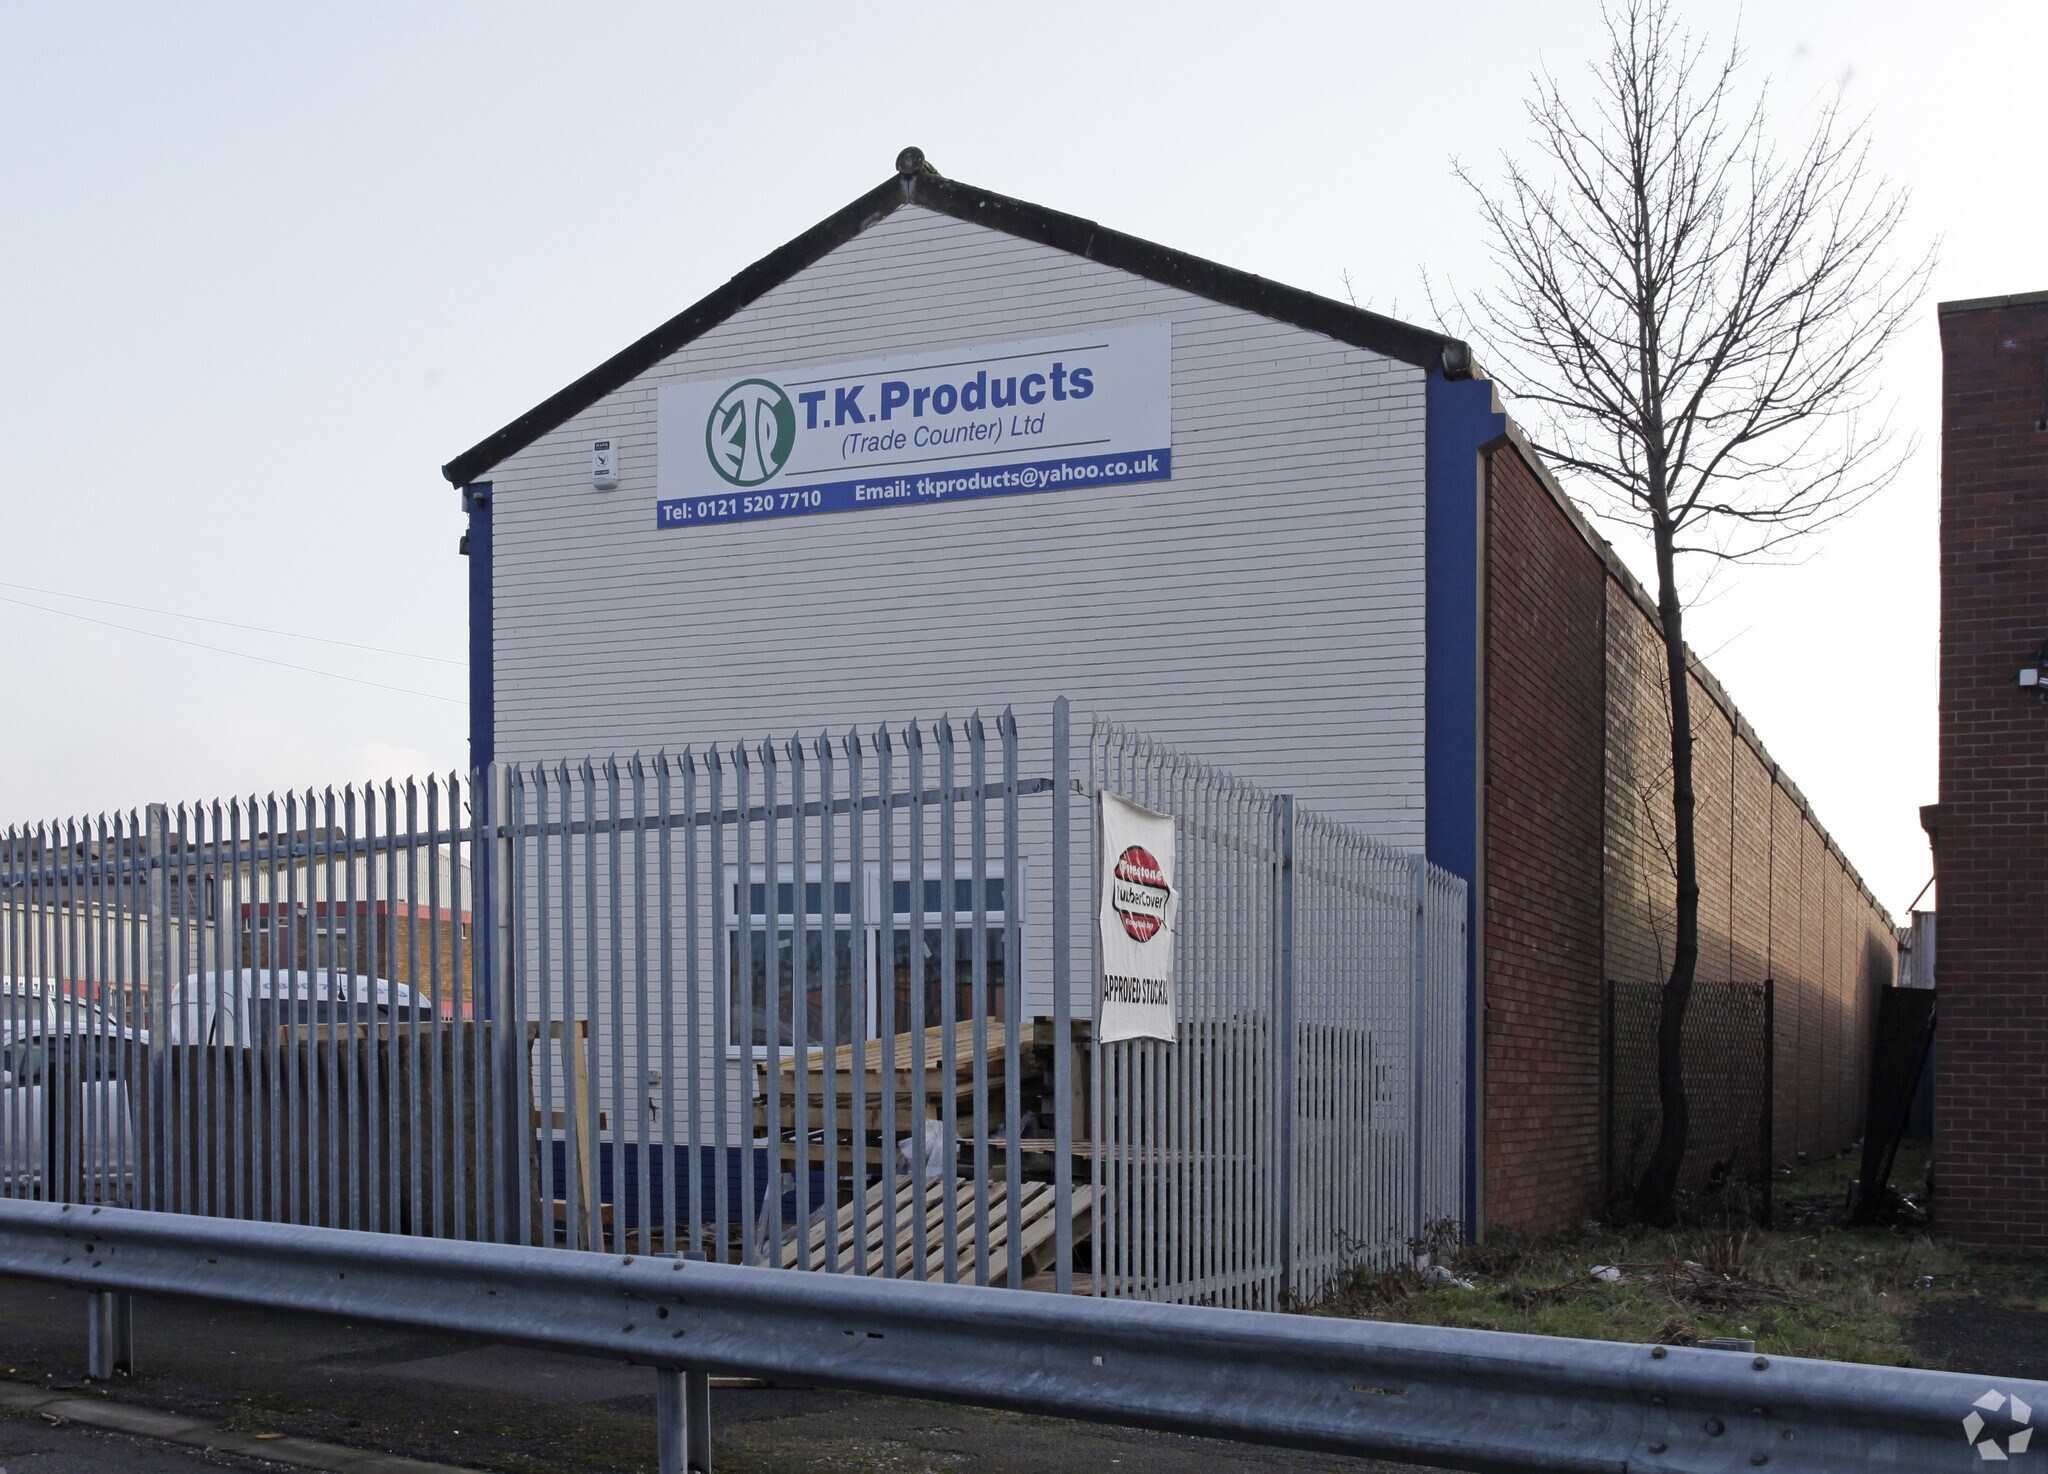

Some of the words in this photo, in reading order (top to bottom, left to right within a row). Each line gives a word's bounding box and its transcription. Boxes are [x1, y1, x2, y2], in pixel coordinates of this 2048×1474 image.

[798, 361, 1095, 430] T.K.Products
[841, 429, 907, 460] (Trade
[913, 417, 1003, 448] Counter)
[1010, 412, 1046, 437] Ltd
[854, 479, 912, 501] Email:
[916, 454, 1159, 498] tkproducts@yahoo.co.uk
[662, 502, 693, 521] Tel:
[697, 498, 737, 518] 0121
[743, 494, 775, 514] 520
[779, 489, 822, 510] 7710
[1103, 974, 1141, 1004] APPROVED
